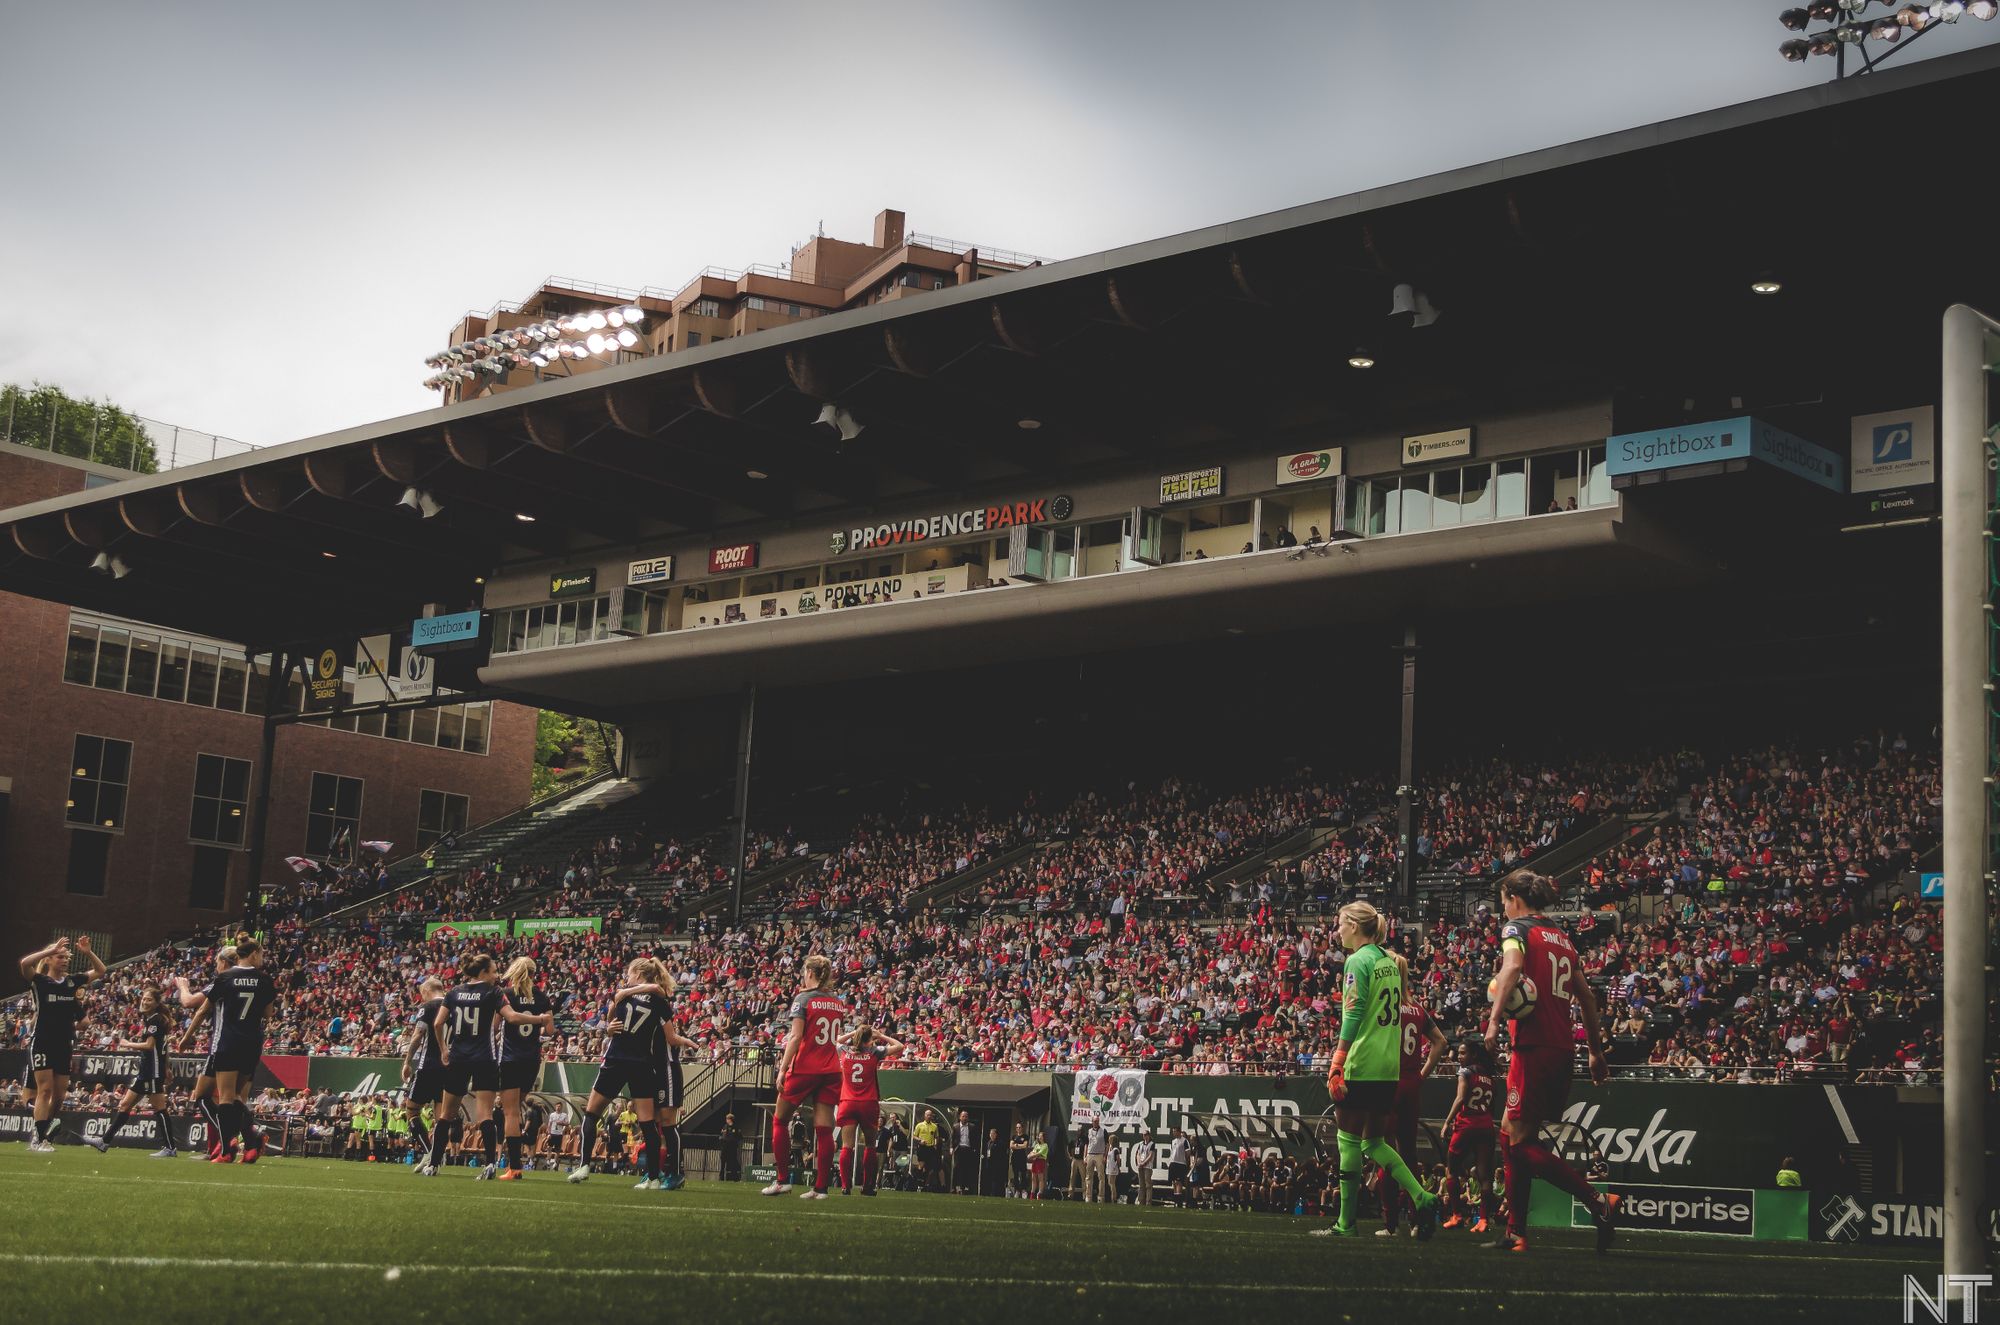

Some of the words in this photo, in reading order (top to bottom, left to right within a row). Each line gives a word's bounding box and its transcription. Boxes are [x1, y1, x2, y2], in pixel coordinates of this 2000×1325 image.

[1423, 439, 1466, 451] TIMBERS.COM
[1622, 434, 1715, 463] Sightbox
[1762, 430, 1822, 474] Sightbox
[1163, 473, 1188, 484] SPORTS
[1192, 468, 1218, 479] SPORTS
[1163, 480, 1188, 496] 750
[1192, 476, 1217, 491] 750
[1882, 497, 1914, 509] Lexmark
[715, 545, 749, 565] ROOT
[721, 560, 745, 570] SPORTS
[562, 576, 590, 588] @TimbersFC
[824, 579, 901, 602] POTLAND
[420, 620, 463, 639] Sightbox
[311, 678, 341, 690] SECURITY
[315, 688, 336, 699] SIGNS
[233, 978, 259, 987] CATLEY
[1548, 951, 1571, 1001] 12
[239, 992, 255, 1020] 7
[457, 992, 481, 1001] TAYLOR
[811, 1001, 845, 1013] BOUREILL
[1377, 987, 1400, 1027] 33
[455, 1006, 480, 1036] 14
[623, 1002, 652, 1035] 17
[815, 1016, 841, 1046] 30
[1403, 1022, 1418, 1057] 6
[851, 1063, 864, 1083] 2
[1072, 1108, 1092, 1118] PETAL
[1108, 1109, 1120, 1118] THE
[1120, 1109, 1142, 1118] METAL
[85, 1118, 157, 1138] @ThrnsFC
[1620, 1194, 1750, 1225] terprise
[1871, 1203, 1943, 1239] STAN
